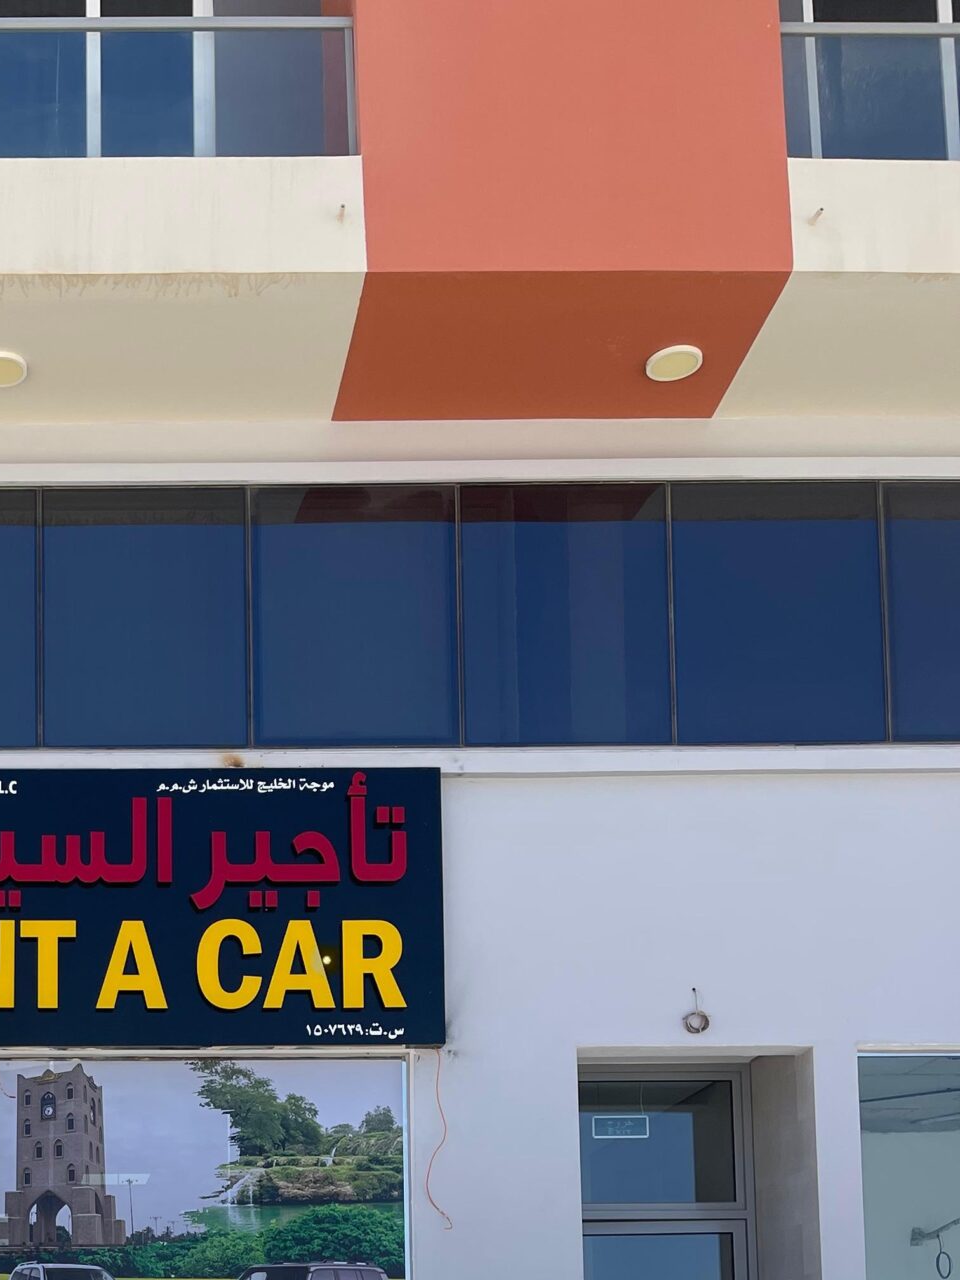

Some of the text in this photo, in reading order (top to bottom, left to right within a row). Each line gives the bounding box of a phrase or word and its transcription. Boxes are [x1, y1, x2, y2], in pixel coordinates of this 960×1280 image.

[198, 778, 255, 793] للاستثمار
[257, 778, 296, 793] الخليج
[298, 778, 335, 793] موجة
[190, 771, 408, 910] تأجير
[95, 919, 169, 1010] A
[196, 918, 408, 1010] CAR
